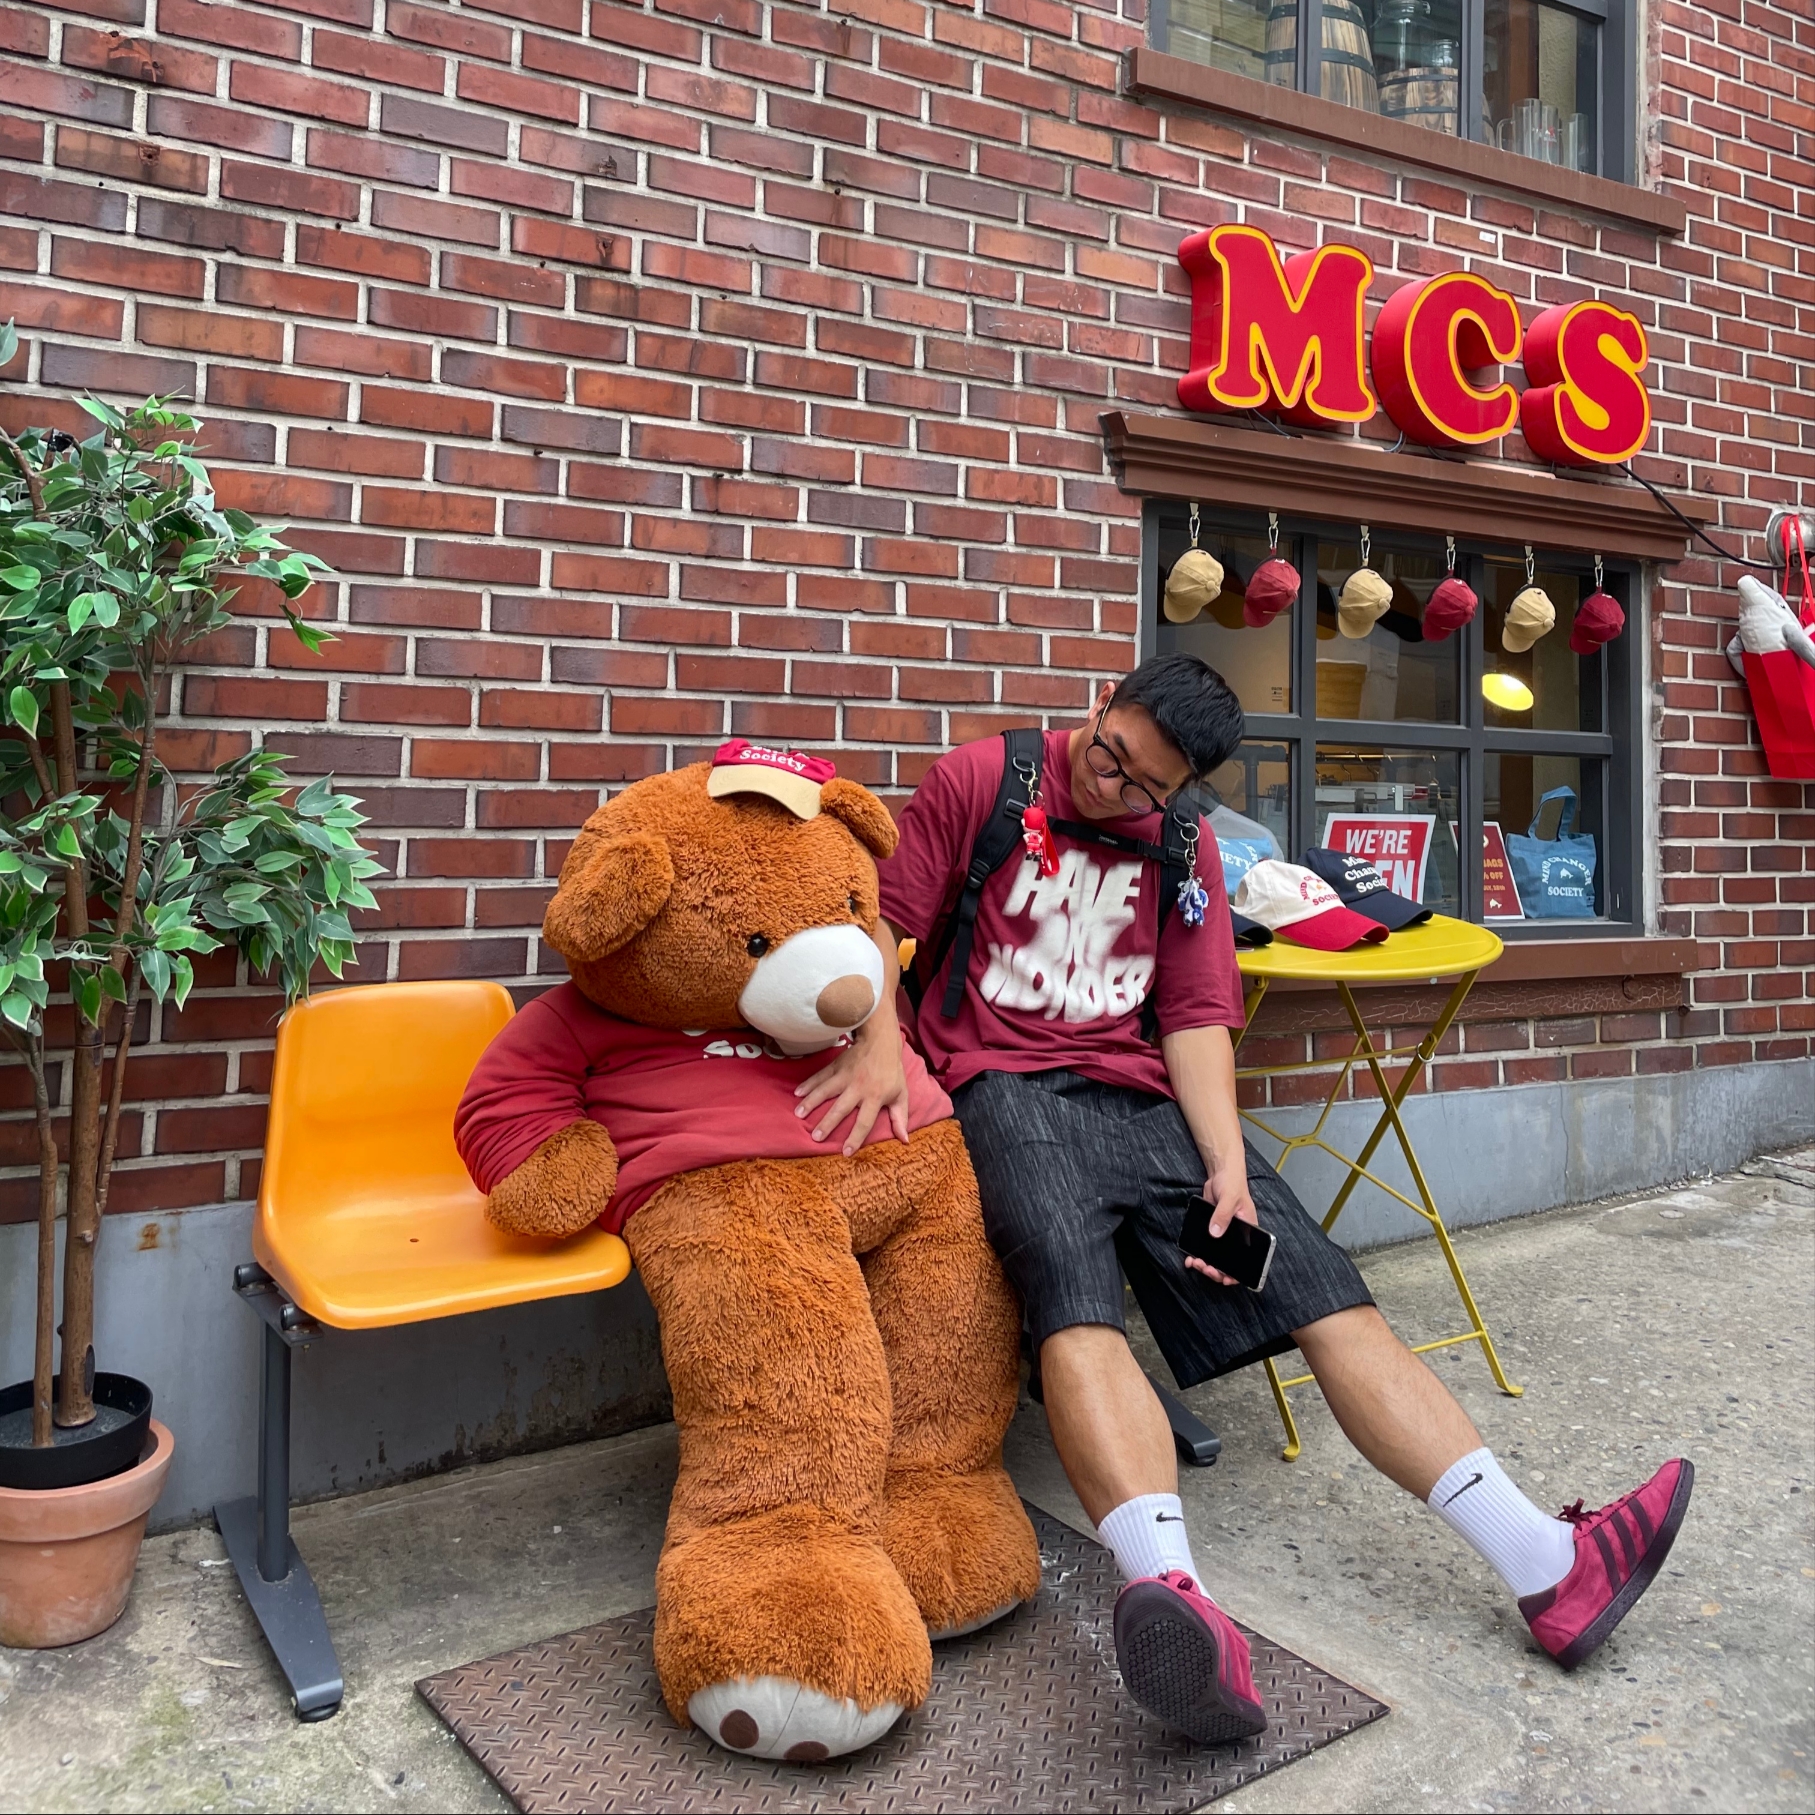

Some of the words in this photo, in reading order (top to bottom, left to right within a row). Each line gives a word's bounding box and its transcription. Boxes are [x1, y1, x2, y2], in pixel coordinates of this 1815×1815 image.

[1206, 223, 1653, 464] MCS
[739, 749, 806, 772] Society
[1345, 828, 1412, 855] WE'RE
[1219, 850, 1253, 871] IETY
[1541, 860, 1552, 885] MIND
[1548, 856, 1592, 886] CHANGER
[1002, 848, 1145, 922] HAVE
[1374, 859, 1416, 901] EN
[1547, 886, 1584, 897] SOCIETY
[979, 942, 1156, 1024] WONDER
